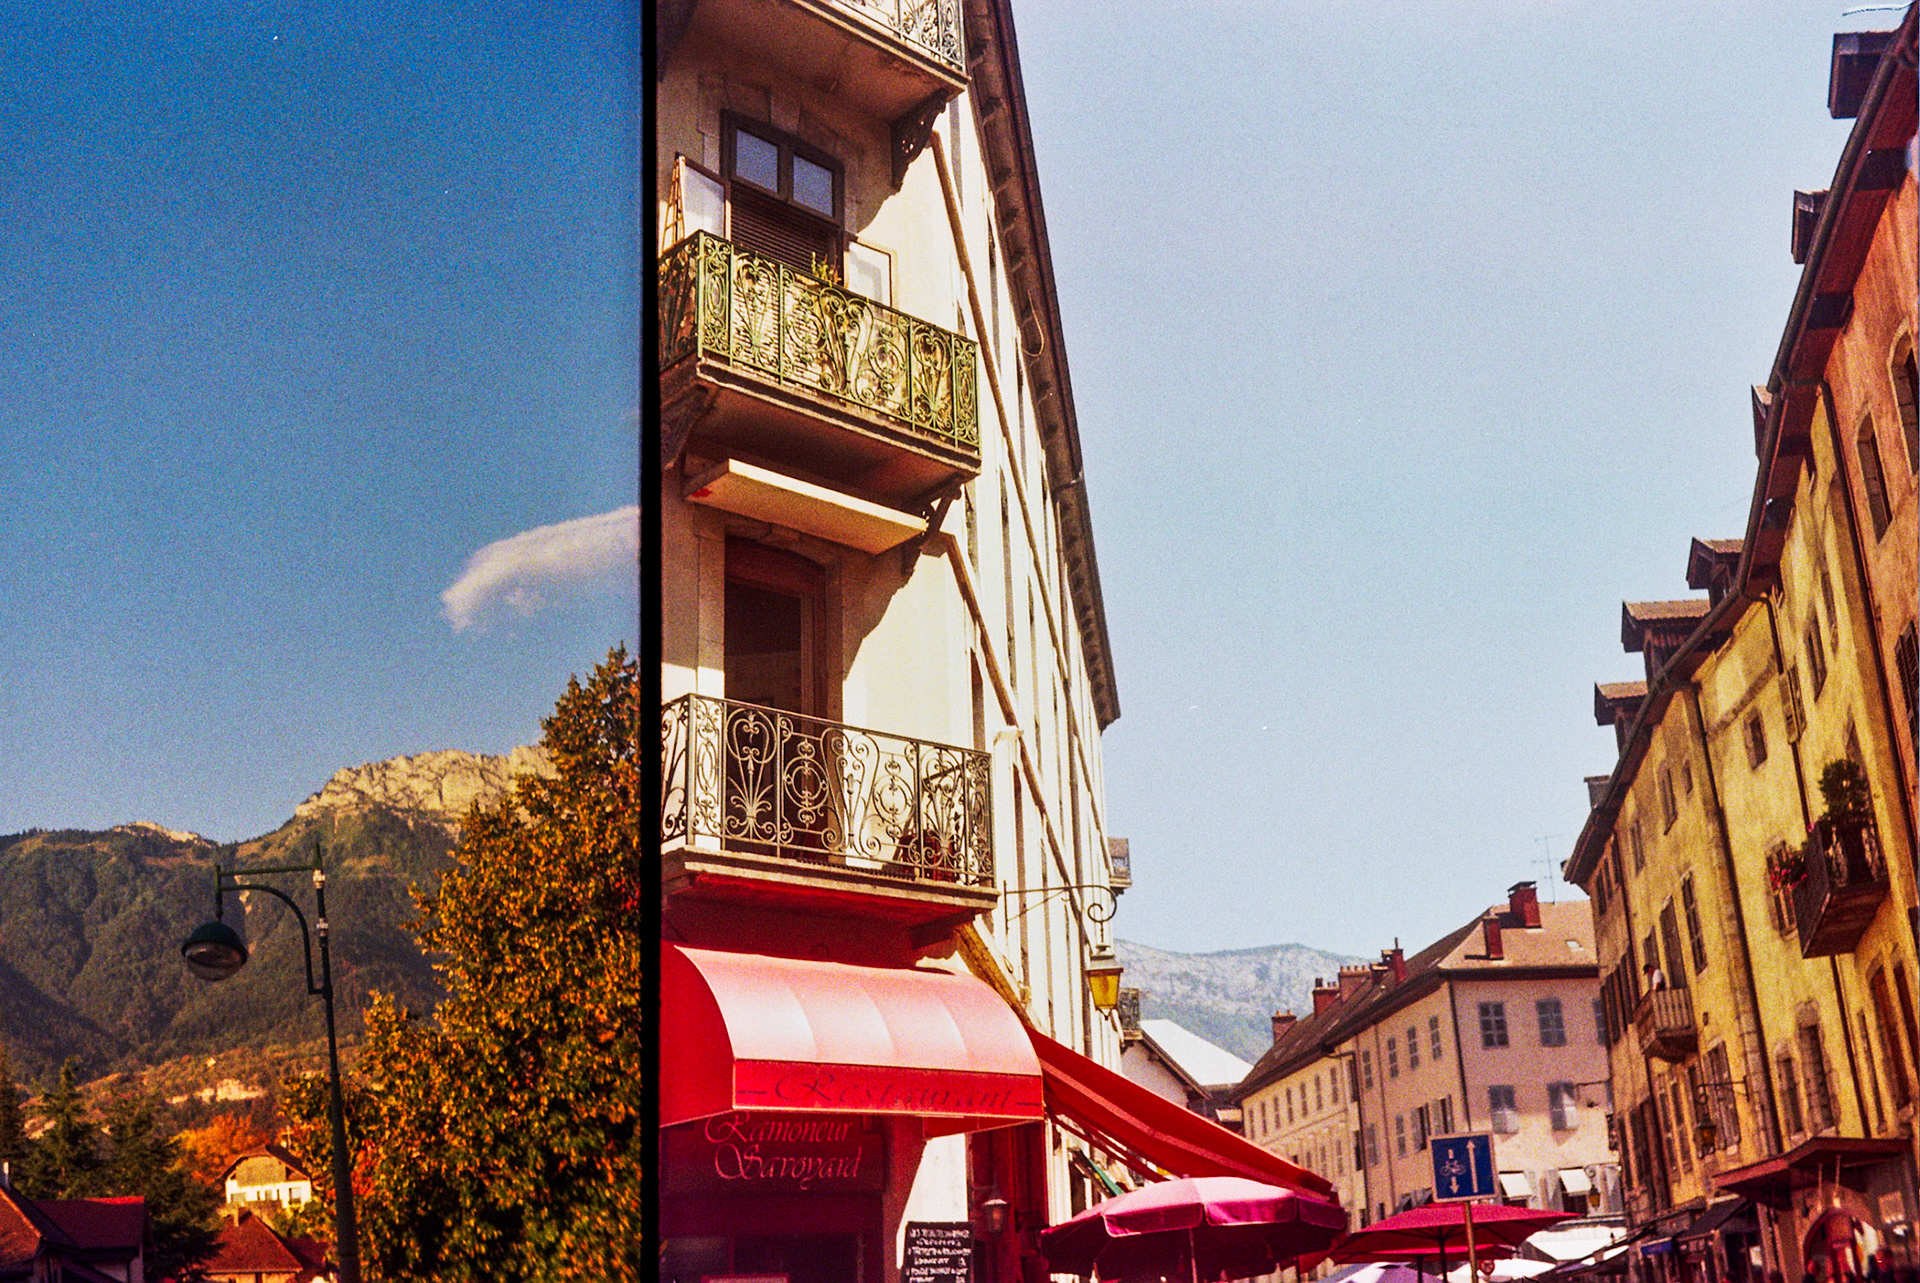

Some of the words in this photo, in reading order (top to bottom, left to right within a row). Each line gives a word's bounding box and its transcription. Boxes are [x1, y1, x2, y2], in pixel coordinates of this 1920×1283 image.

[775, 1073, 1012, 1109] Restaurant
[705, 1112, 853, 1143] Ramoneur
[715, 1143, 863, 1190] Savoyard
